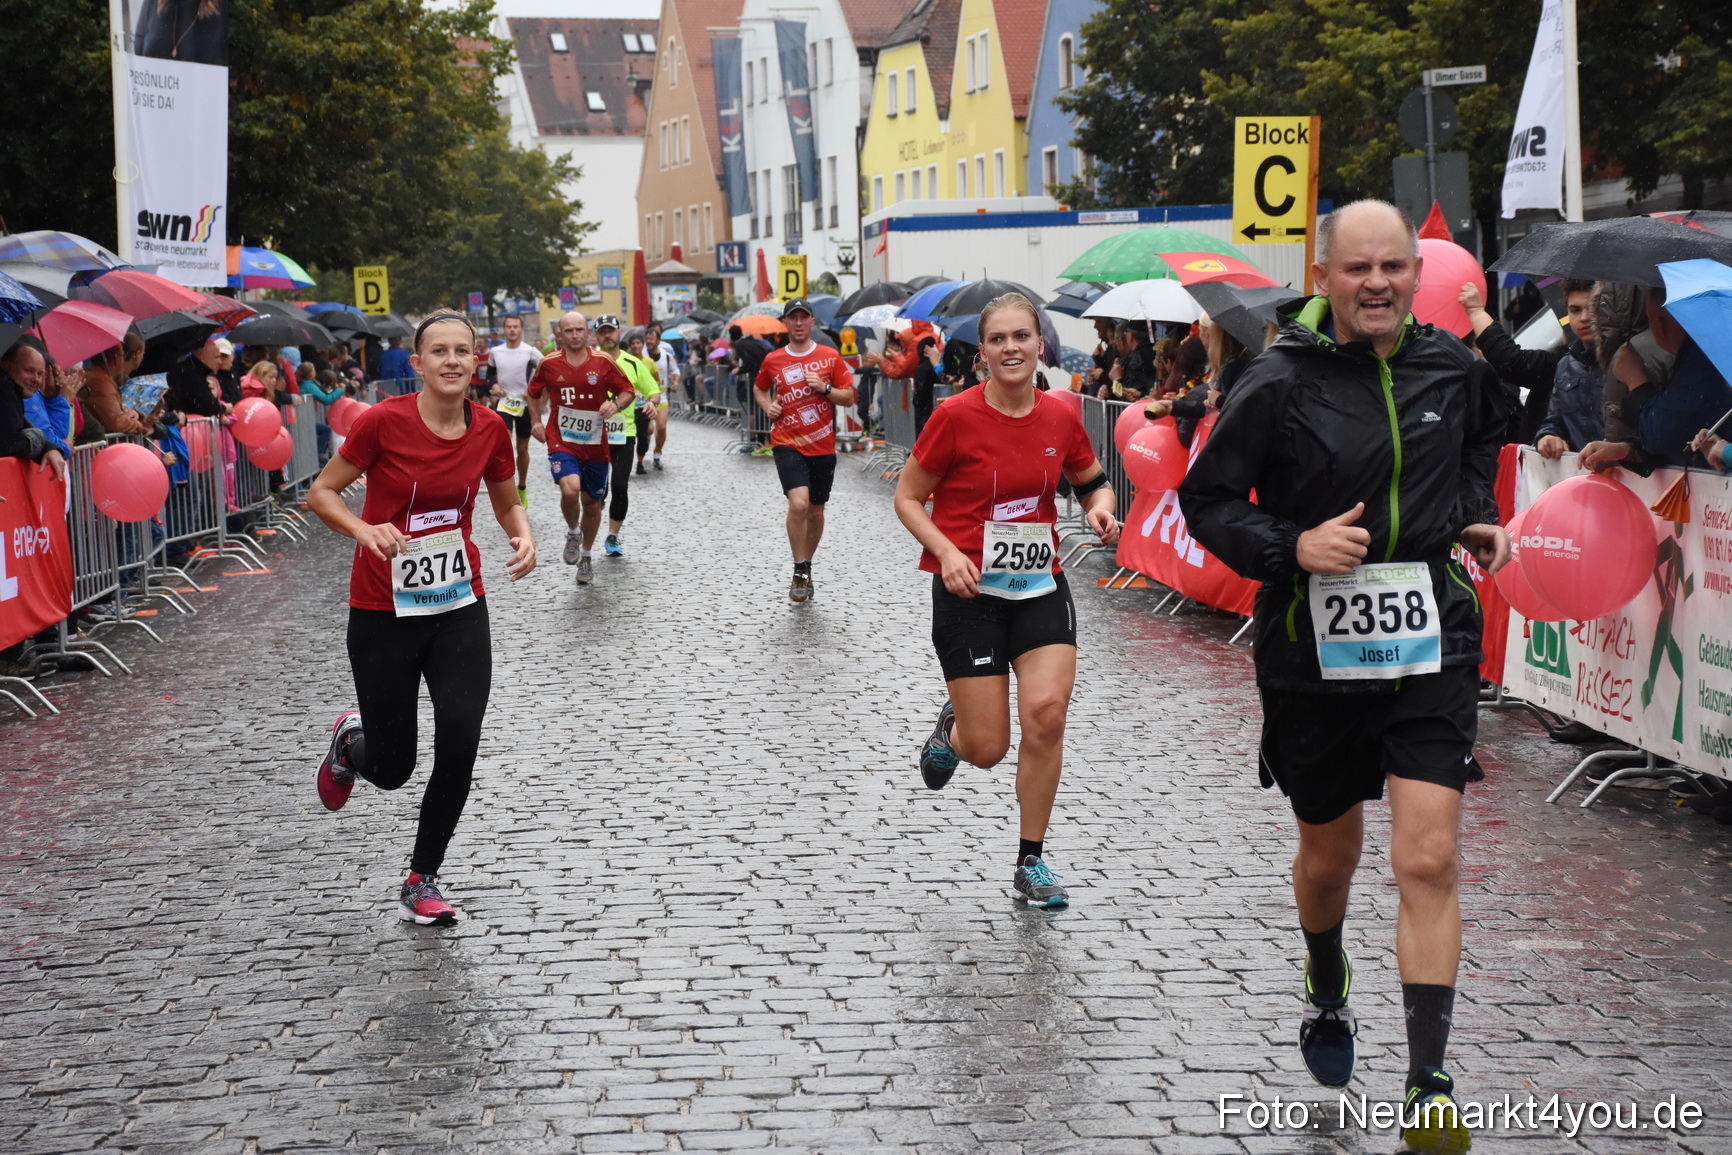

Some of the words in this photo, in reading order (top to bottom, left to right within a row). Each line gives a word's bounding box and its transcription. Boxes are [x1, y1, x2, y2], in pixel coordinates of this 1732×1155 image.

[1459, 70, 1482, 80] Gasse
[142, 93, 155, 108] SIE
[157, 95, 175, 110] DA!
[1245, 122, 1309, 145] Block
[1254, 155, 1297, 217] C
[137, 209, 192, 242] swn
[170, 244, 208, 257] neumarkt
[781, 256, 804, 266] Block
[358, 268, 383, 279] Block
[785, 270, 800, 292] D
[364, 281, 381, 305] D
[561, 415, 592, 432] 2798
[1007, 502, 1026, 515] DEHN
[423, 515, 445, 524] DEHN
[1023, 525, 1048, 536] BOCK
[425, 533, 461, 548] BOCK
[991, 541, 1052, 571] 2599
[1543, 550, 1580, 560] energie
[401, 549, 467, 588] 2374
[1319, 578, 1358, 588] NeuerMarkt
[1365, 566, 1421, 583] BOCK
[1008, 578, 1027, 591] Anja
[413, 588, 458, 604] Veronika
[1325, 590, 1428, 635] 2358
[1359, 645, 1400, 663] Josef
